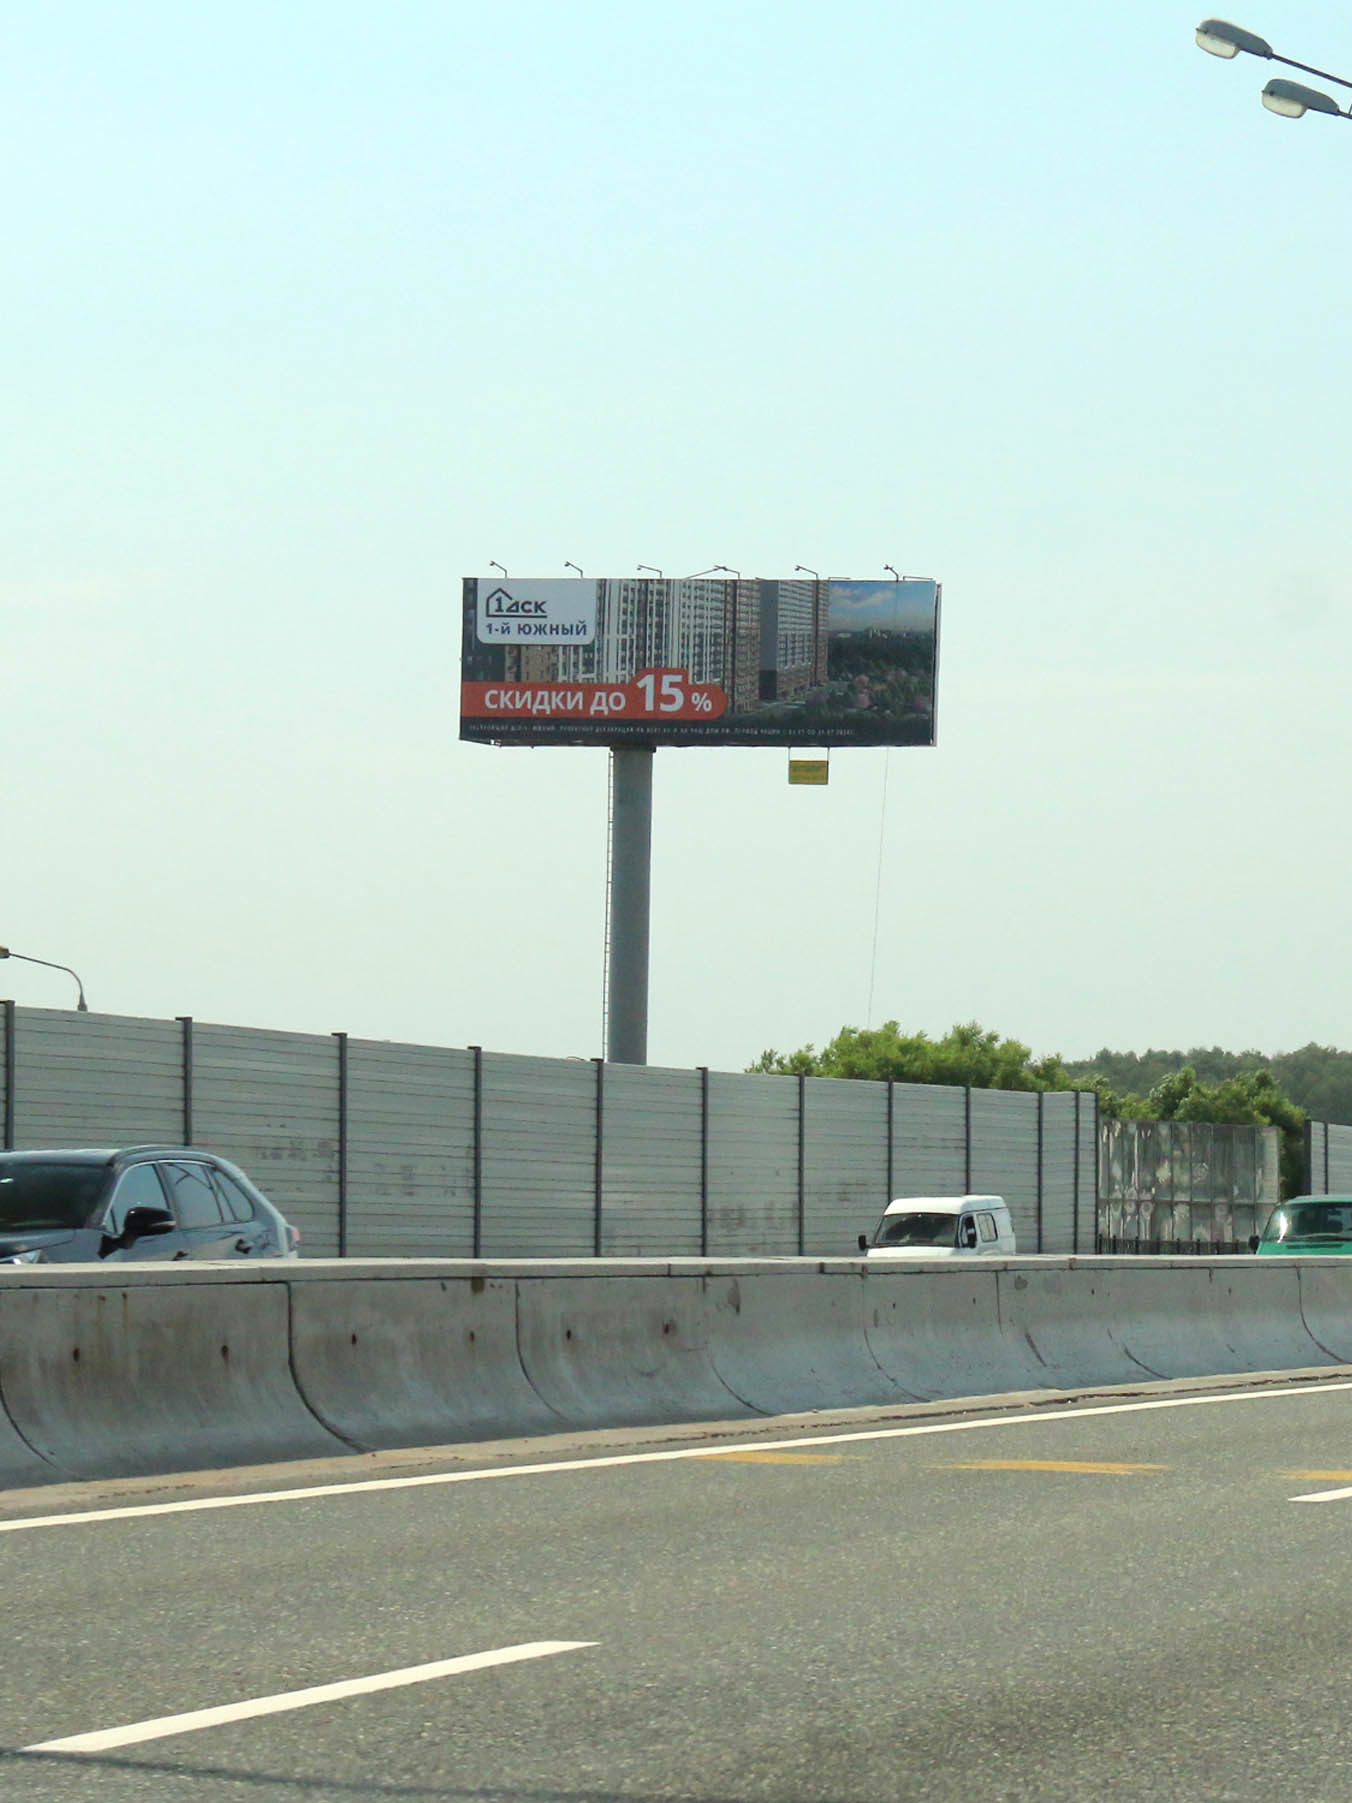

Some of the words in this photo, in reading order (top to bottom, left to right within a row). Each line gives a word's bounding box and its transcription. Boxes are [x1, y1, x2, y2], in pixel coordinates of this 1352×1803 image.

[517, 619, 588, 636] ЮЖНЫЙ
[484, 690, 584, 714] СКИДКИ
[589, 691, 626, 715] ДО
[637, 674, 685, 712] 15
[691, 692, 713, 712] %
